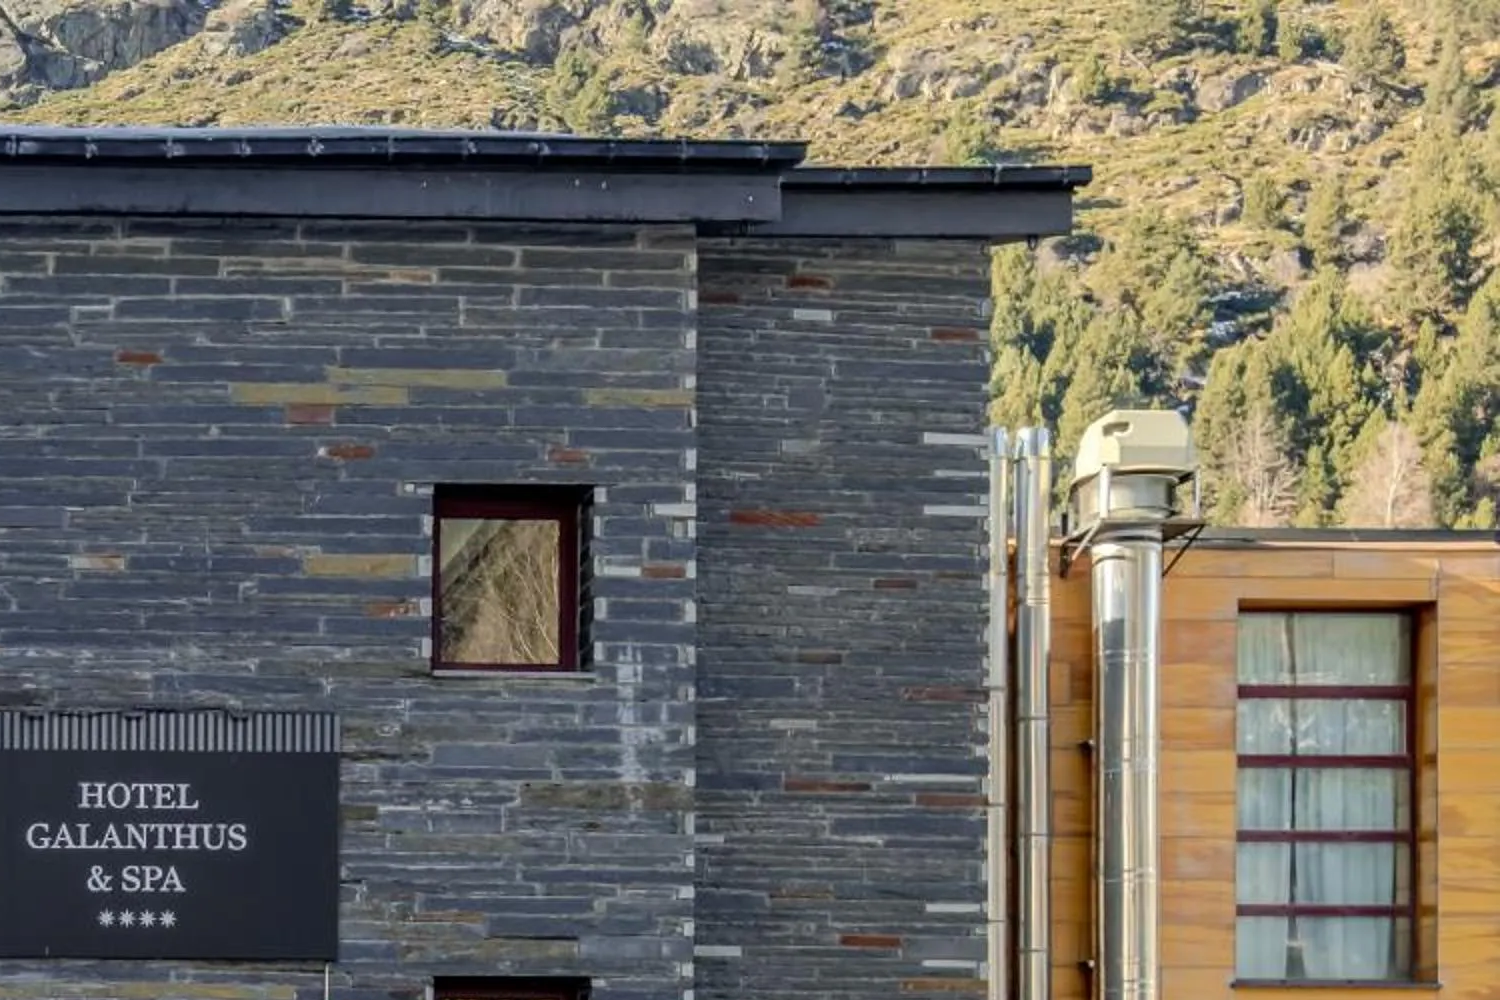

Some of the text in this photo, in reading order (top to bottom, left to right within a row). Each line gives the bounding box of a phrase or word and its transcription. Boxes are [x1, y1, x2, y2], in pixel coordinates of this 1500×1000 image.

[78, 781, 199, 810] HOTEL
[25, 822, 248, 851] GALANTHUS
[86, 865, 186, 892] & SPA
